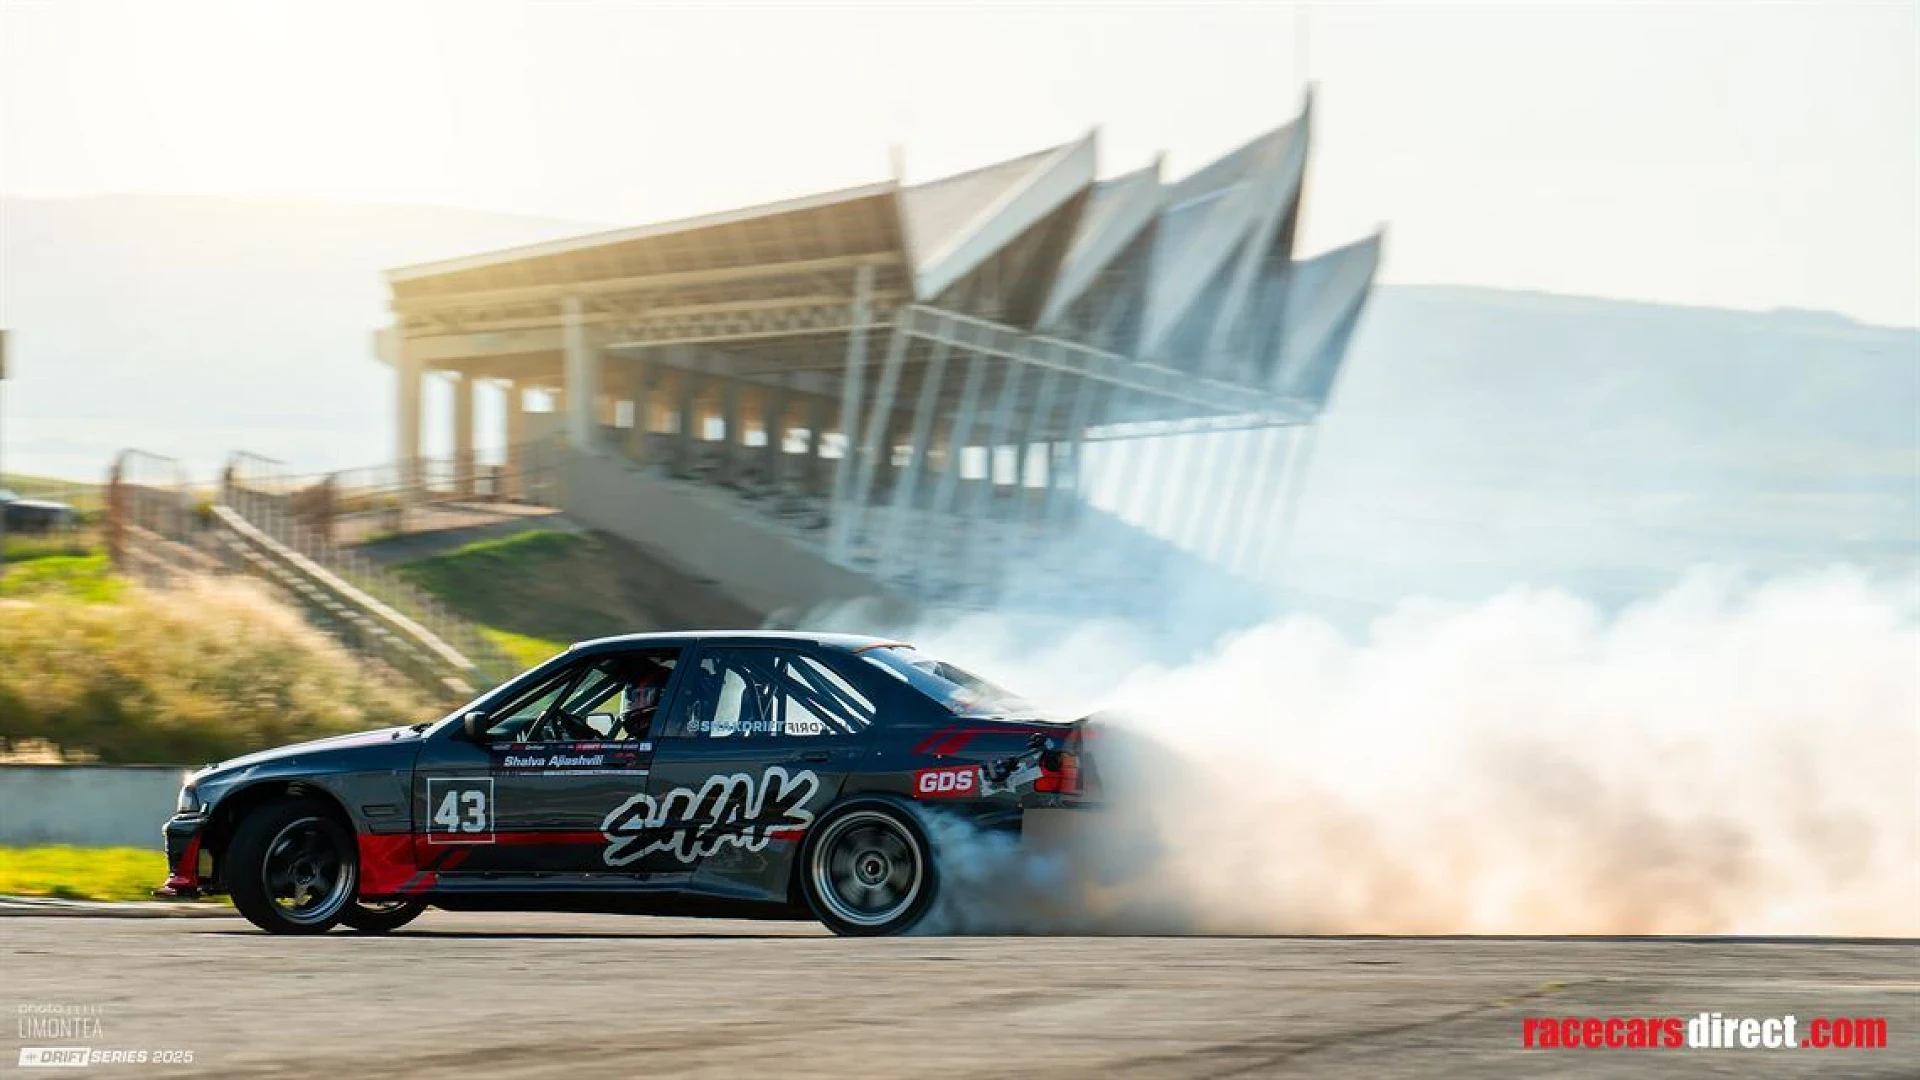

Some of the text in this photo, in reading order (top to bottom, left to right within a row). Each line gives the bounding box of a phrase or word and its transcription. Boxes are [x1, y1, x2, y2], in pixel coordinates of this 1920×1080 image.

[504, 756, 545, 767] Shalva
[919, 770, 973, 793] GDS
[433, 790, 486, 833] 43
